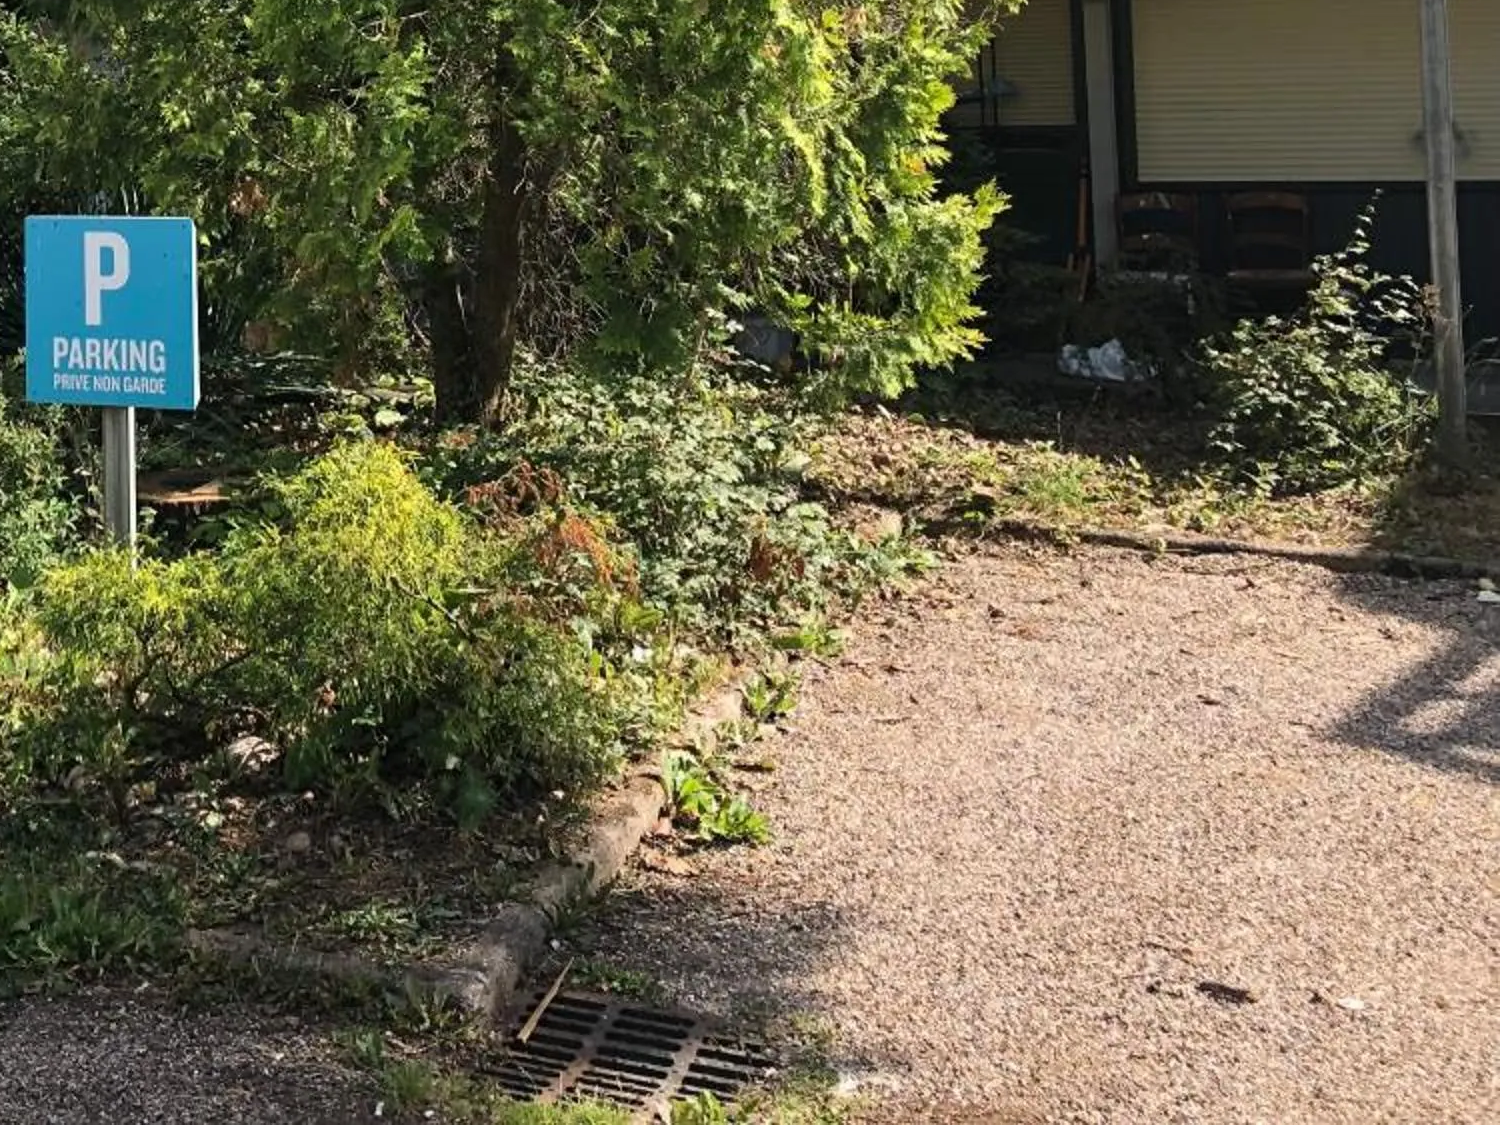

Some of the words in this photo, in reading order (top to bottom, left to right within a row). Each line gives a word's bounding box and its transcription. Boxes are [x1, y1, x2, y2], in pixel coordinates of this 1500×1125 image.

[83, 230, 131, 326] P
[52, 336, 167, 373] PARKING
[53, 373, 90, 392] PRIVE
[93, 375, 121, 393] NON
[123, 376, 167, 395] GARDE
